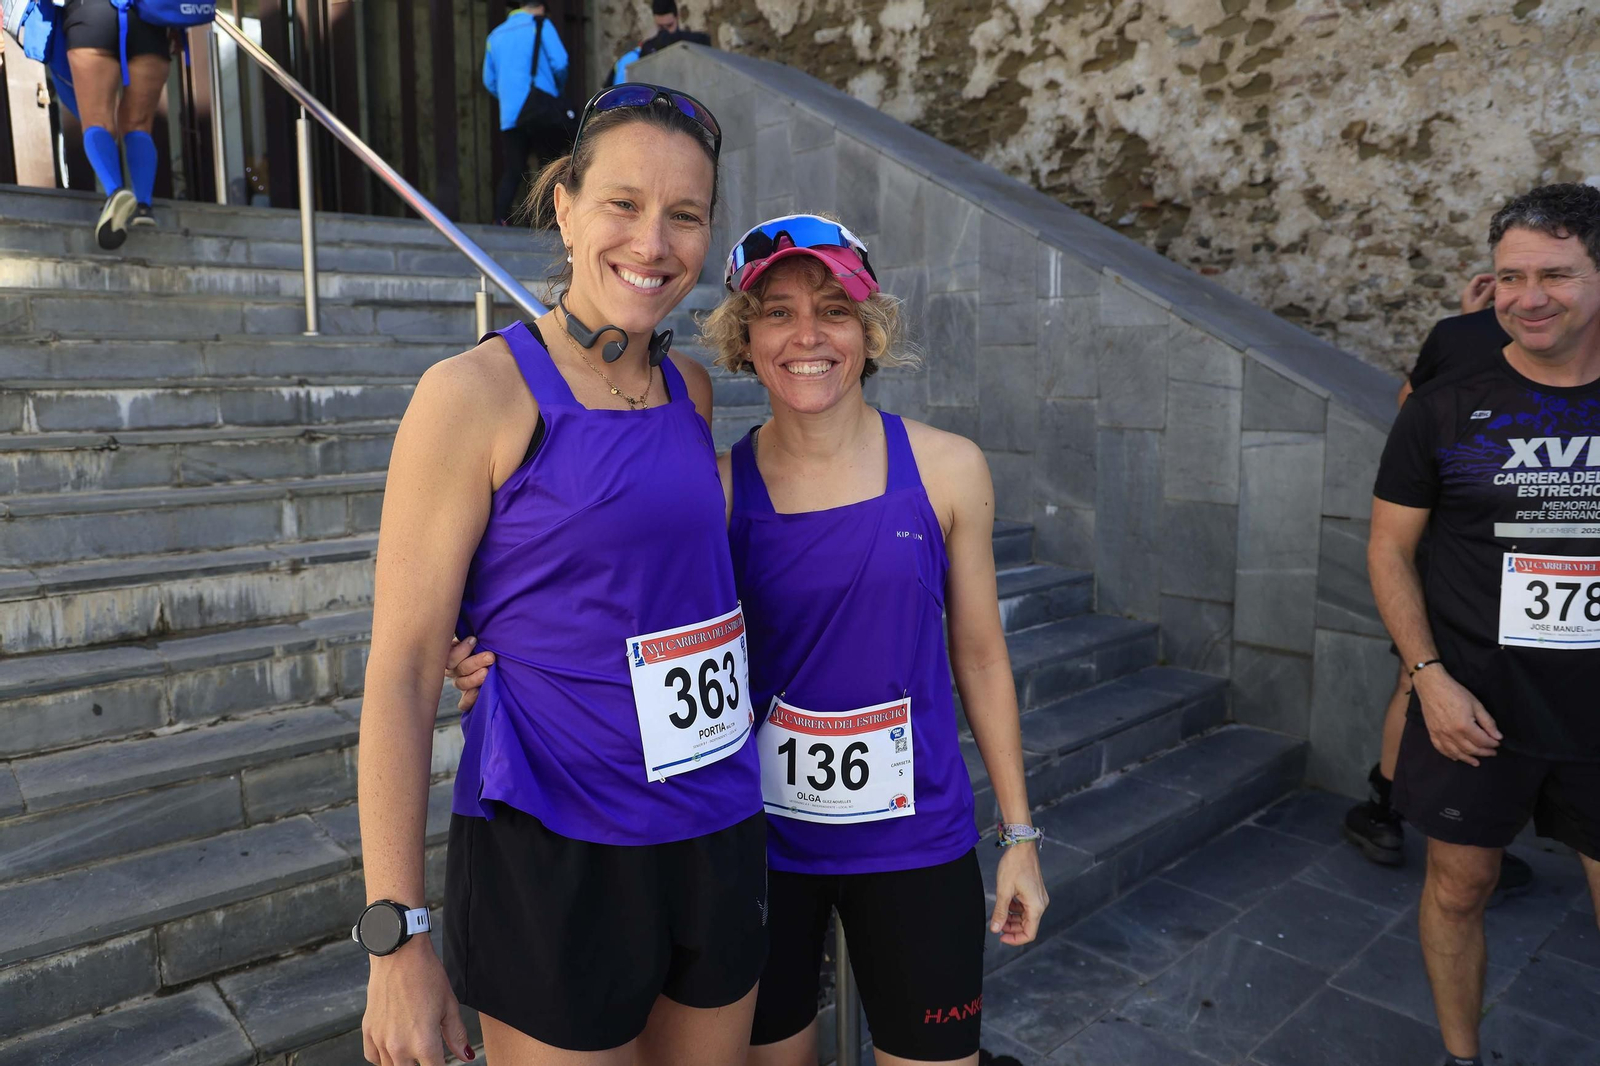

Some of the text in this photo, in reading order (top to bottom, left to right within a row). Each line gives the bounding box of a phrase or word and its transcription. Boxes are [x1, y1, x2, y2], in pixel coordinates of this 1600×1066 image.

[1493, 471, 1600, 485] CARRERA DEL
[1515, 511, 1546, 520] PEPE
[1533, 562, 1578, 571] CARRERA
[1579, 563, 1598, 571] DEL
[1525, 580, 1600, 622] 378
[1530, 624, 1550, 632] JOSE
[1553, 625, 1585, 633] MANUEL
[665, 632, 712, 651] CARRERA
[664, 651, 740, 730] 363
[784, 713, 832, 729] CARRERA
[834, 719, 856, 730] DEL
[856, 708, 906, 728] ESTRECHO
[699, 722, 726, 740] PORTIA
[778, 737, 870, 791] 136
[890, 759, 911, 768] CAMISETA
[898, 769, 904, 777] S
[796, 791, 821, 803] OLGA
